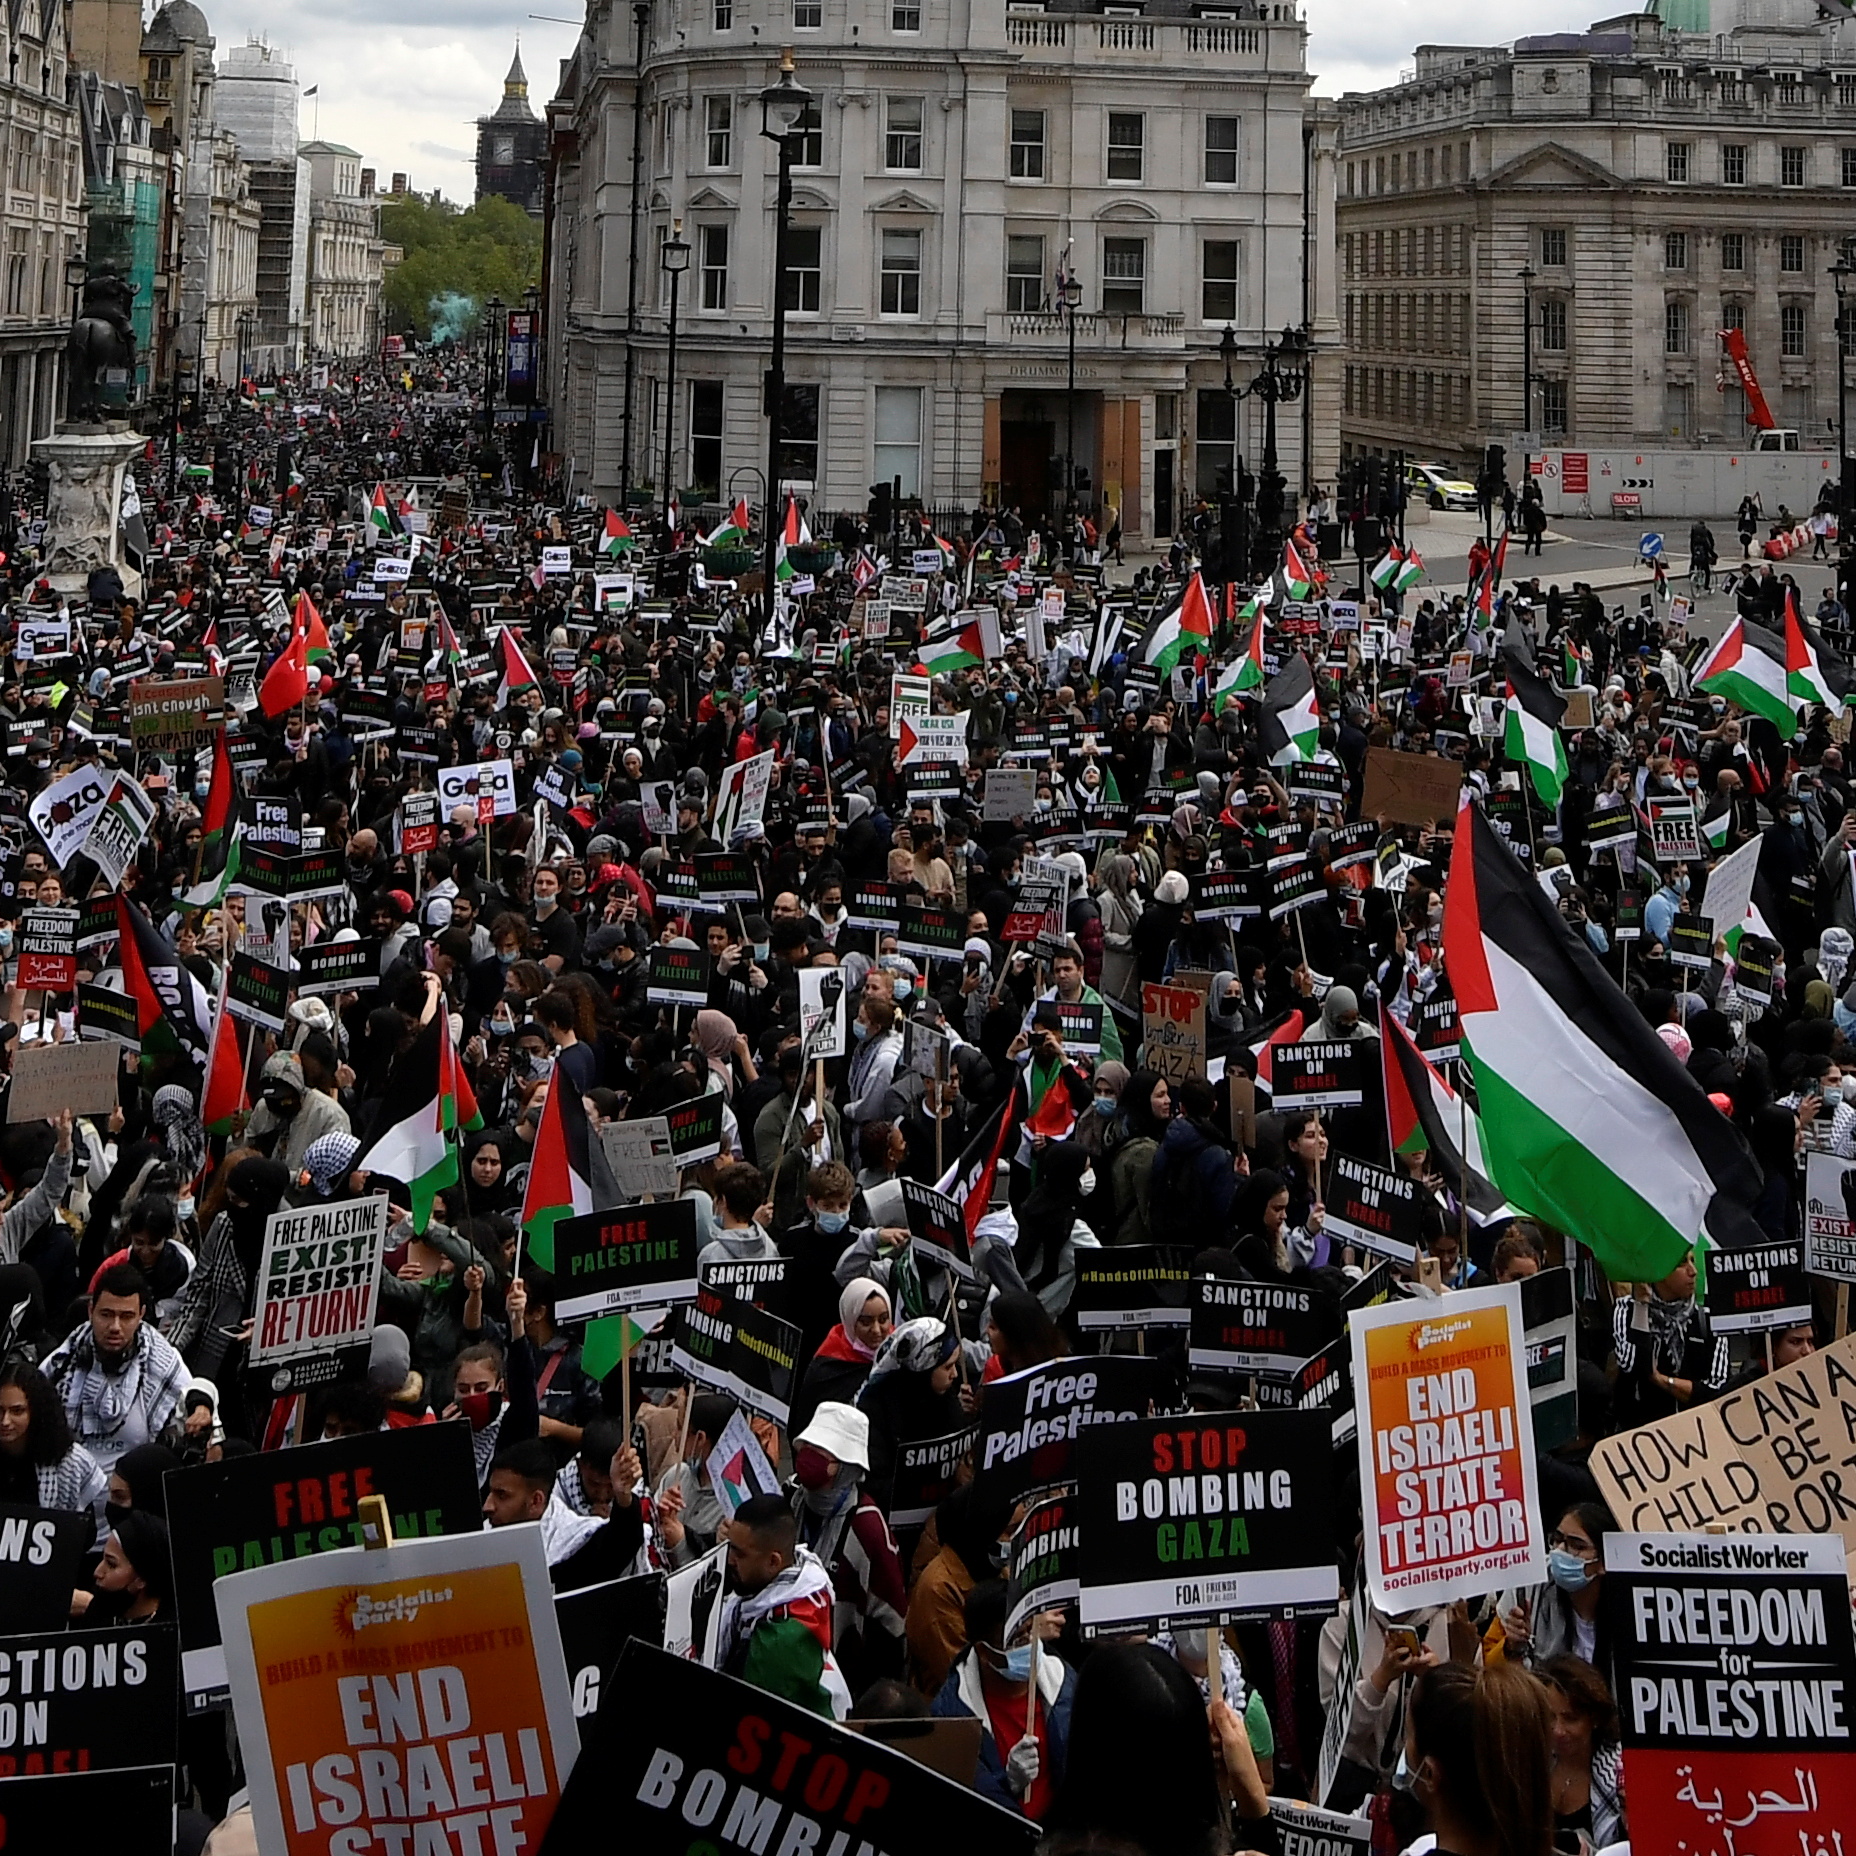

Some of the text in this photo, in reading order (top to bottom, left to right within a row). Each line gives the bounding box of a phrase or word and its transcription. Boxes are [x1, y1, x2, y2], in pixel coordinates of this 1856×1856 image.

[1010, 365, 1097, 377] DRUMMONDS
[1613, 494, 1639, 503] SLOW
[256, 802, 288, 822] Free
[238, 822, 301, 845] Palestine
[1142, 983, 1200, 1024] STOP
[1146, 1045, 1197, 1079] GAZA
[1277, 1043, 1352, 1063] SANCTIONS
[1306, 1060, 1324, 1075] ON
[1293, 1073, 1339, 1090] ISRAEL
[272, 1204, 380, 1247] FREE PALESTINE
[600, 1220, 648, 1247] FREE
[1809, 1218, 1856, 1237] EXIST.
[269, 1234, 377, 1277] EXIST!
[571, 1239, 679, 1276] PALESTINE
[1712, 1247, 1798, 1273] SANCTIONS
[266, 1262, 374, 1300] RESIST!
[1734, 1286, 1786, 1307] ISRAEL
[1749, 1270, 1769, 1289] ON
[260, 1285, 371, 1349] RETURN!
[1421, 1320, 1473, 1339] Socialist
[1371, 1345, 1507, 1382] BUILD A MASS MOVEMENT TO
[1406, 1367, 1477, 1423] END
[1153, 1427, 1247, 1473] STOP
[1376, 1406, 1515, 1476] ISRAELI
[1602, 1416, 1709, 1500] HOW
[1719, 1370, 1821, 1446] CAN
[272, 1467, 374, 1528] FREE
[1116, 1469, 1292, 1523] BOMBING
[1395, 1455, 1504, 1519] STATE
[1632, 1461, 1759, 1535] CHILD
[1770, 1418, 1831, 1481] BE
[212, 1509, 444, 1579] PALESTNE
[1156, 1517, 1250, 1563] GAZA
[1380, 1499, 1526, 1571] TERROR
[1383, 1550, 1531, 1593] socialistparty.org.uk
[356, 1586, 454, 1614] Socialist
[1176, 1584, 1201, 1606] FOA
[1632, 1586, 1828, 1647] FREEDOM
[1718, 1647, 1751, 1676] for
[337, 1665, 472, 1746] END
[1630, 1677, 1850, 1739] PALESTINE
[286, 1727, 549, 1834] ISRAELI
[727, 1714, 891, 1824] STOP
[1676, 1764, 1819, 1827] الحرية
